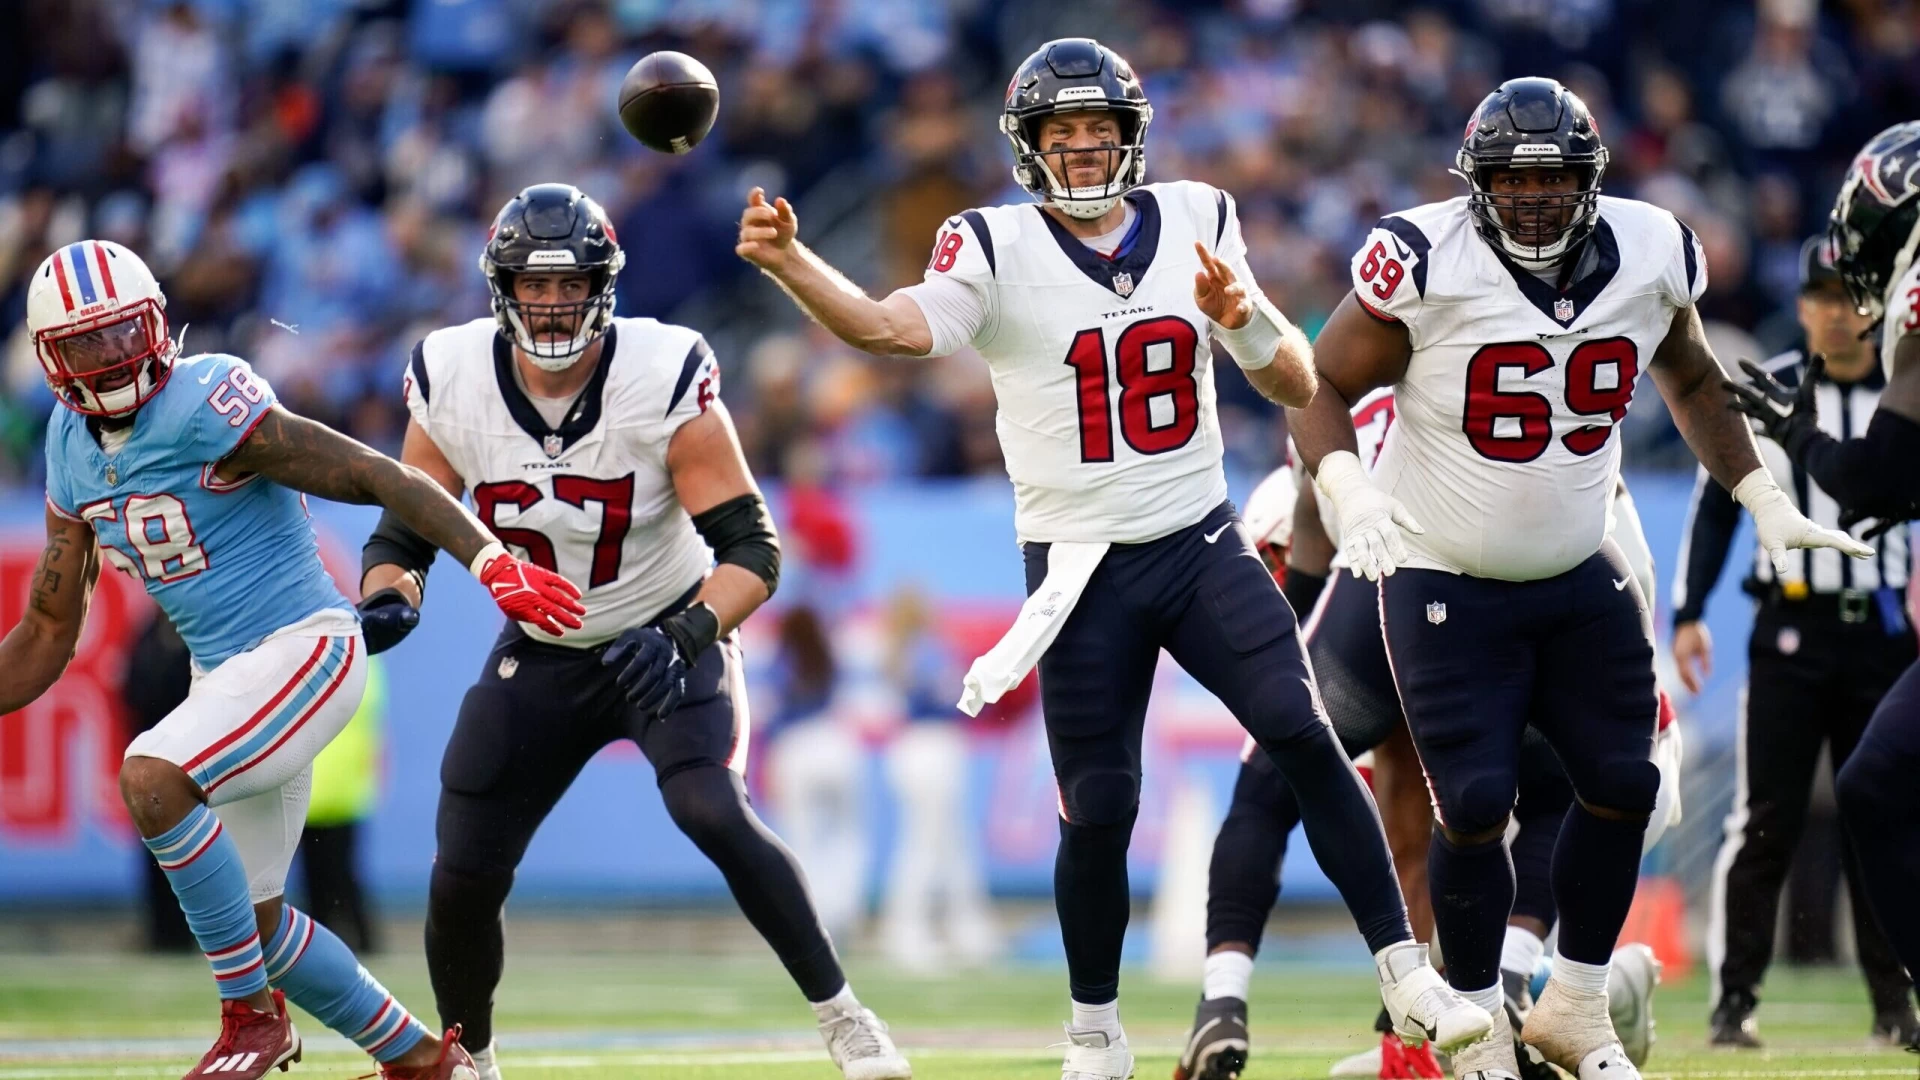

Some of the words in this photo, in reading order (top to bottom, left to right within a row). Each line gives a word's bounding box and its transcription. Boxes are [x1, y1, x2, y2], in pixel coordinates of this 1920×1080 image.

[926, 230, 964, 273] 18
[1359, 240, 1404, 300] 69
[80, 304, 106, 316] OILERS
[1101, 305, 1154, 319] TEXANS
[208, 366, 265, 427] 58
[1064, 315, 1200, 463] 18
[1464, 336, 1639, 463] 69
[521, 462, 572, 471] TEXANS
[78, 492, 209, 584] 58
[474, 471, 635, 588] 67
